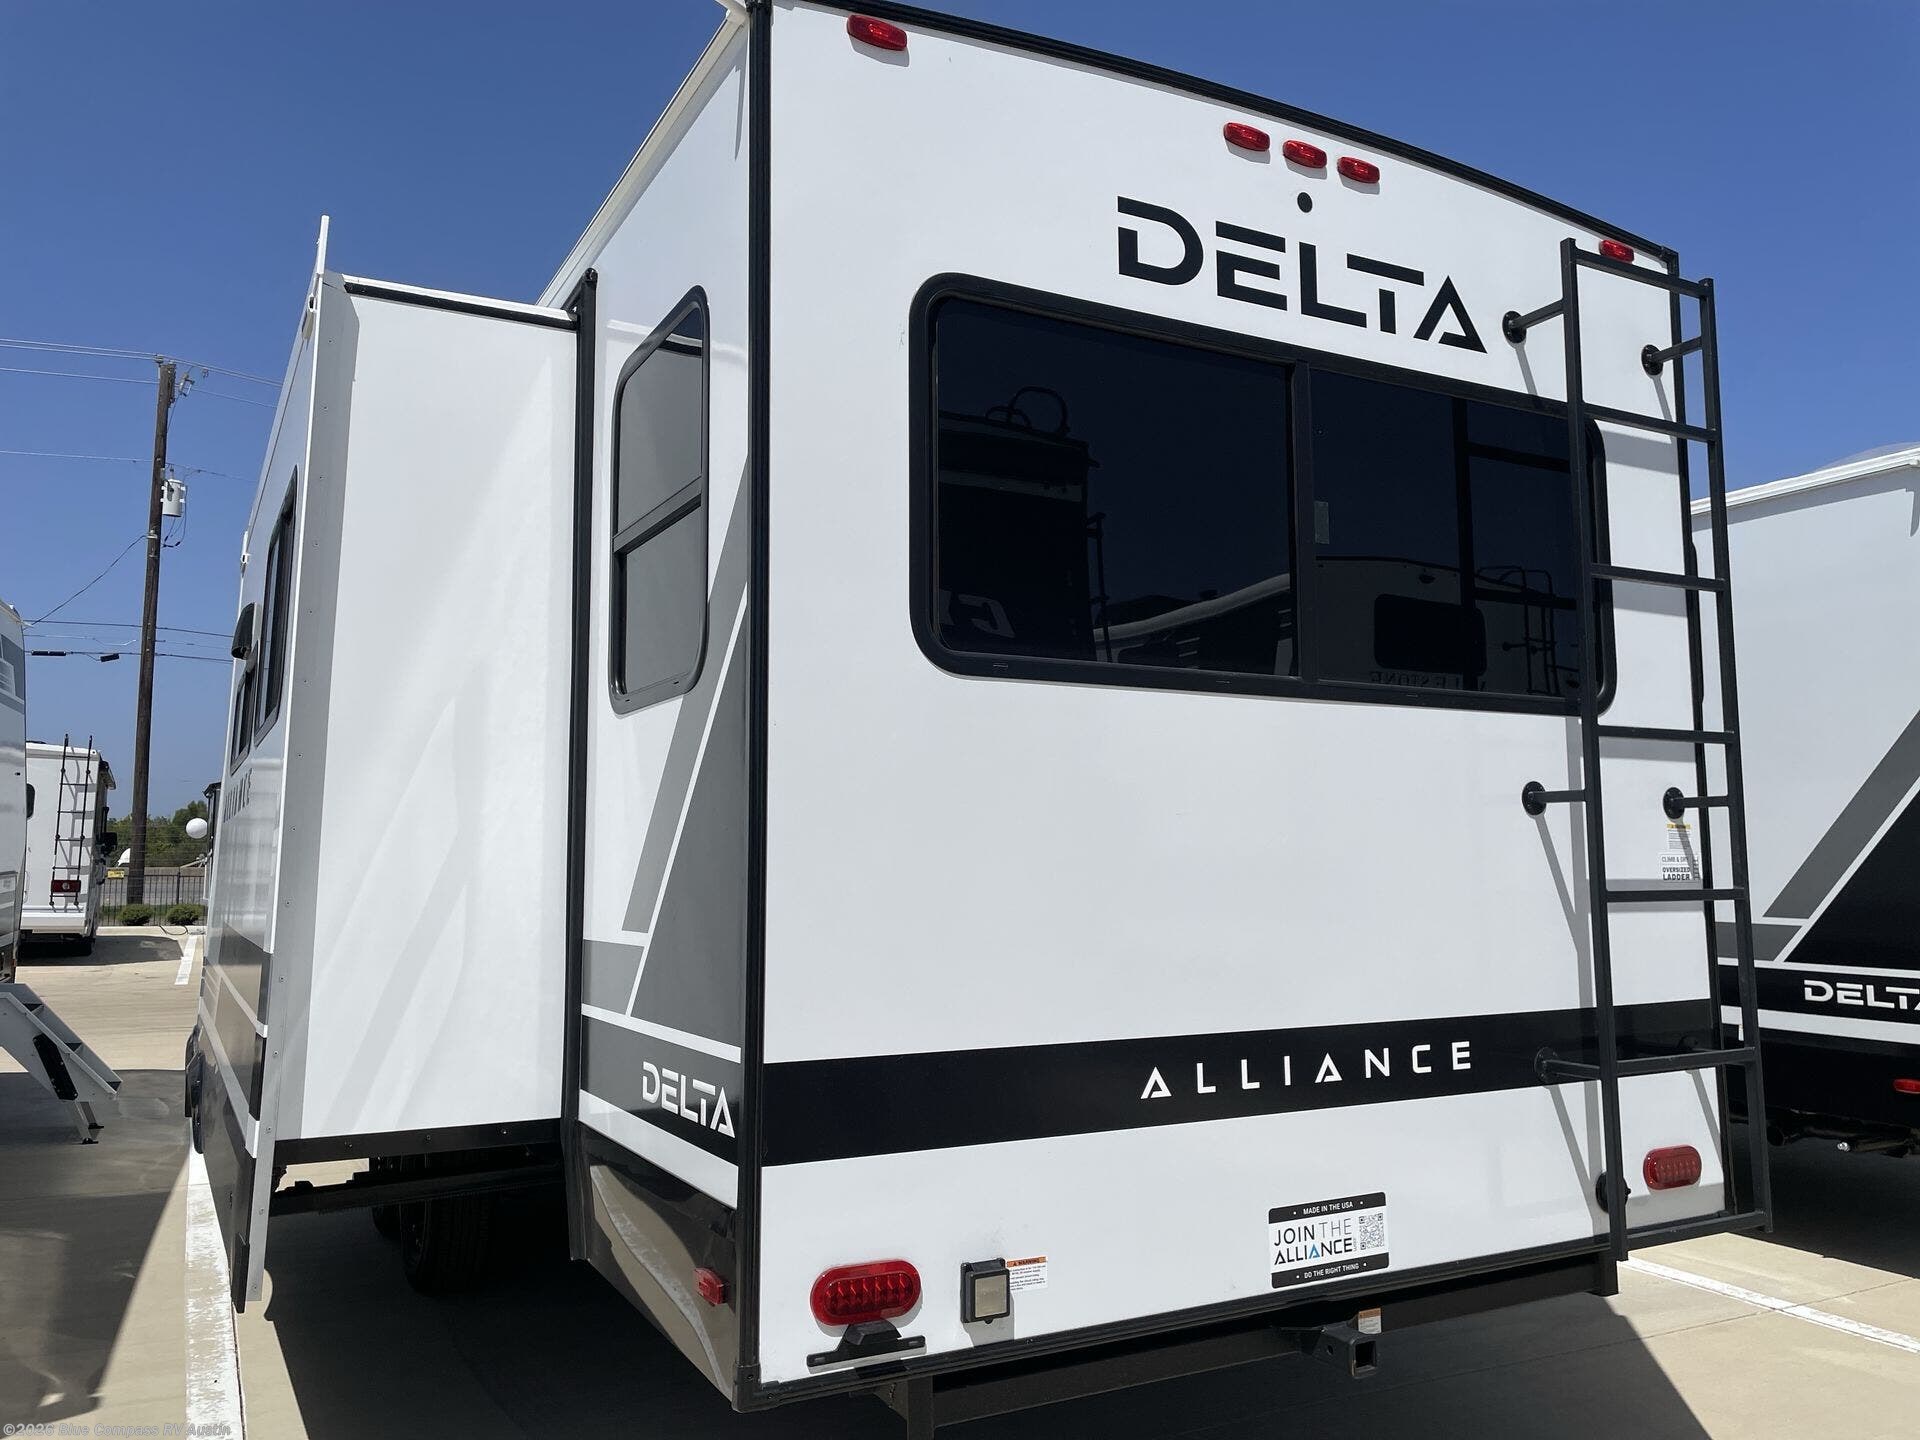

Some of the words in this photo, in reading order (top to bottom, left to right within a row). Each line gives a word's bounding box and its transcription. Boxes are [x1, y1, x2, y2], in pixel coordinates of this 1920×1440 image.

[1117, 195, 1488, 354] DELTA
[1662, 873, 1691, 881] LADDER
[1804, 979, 1920, 1011] DELT
[1140, 1040, 1472, 1100] ALLIANCE
[642, 1060, 736, 1139] DELTA
[1303, 1206, 1320, 1215] MADE
[1329, 1203, 1341, 1211] THE
[1341, 1201, 1354, 1209] USA
[1274, 1224, 1315, 1247] JOIN
[1319, 1218, 1352, 1239] THE
[1274, 1237, 1353, 1266] ALLIANCE
[1304, 1271, 1313, 1279] DO
[1313, 1269, 1324, 1277] THE
[1325, 1266, 1341, 1275] RIGHT
[1342, 1262, 1360, 1272] THING
